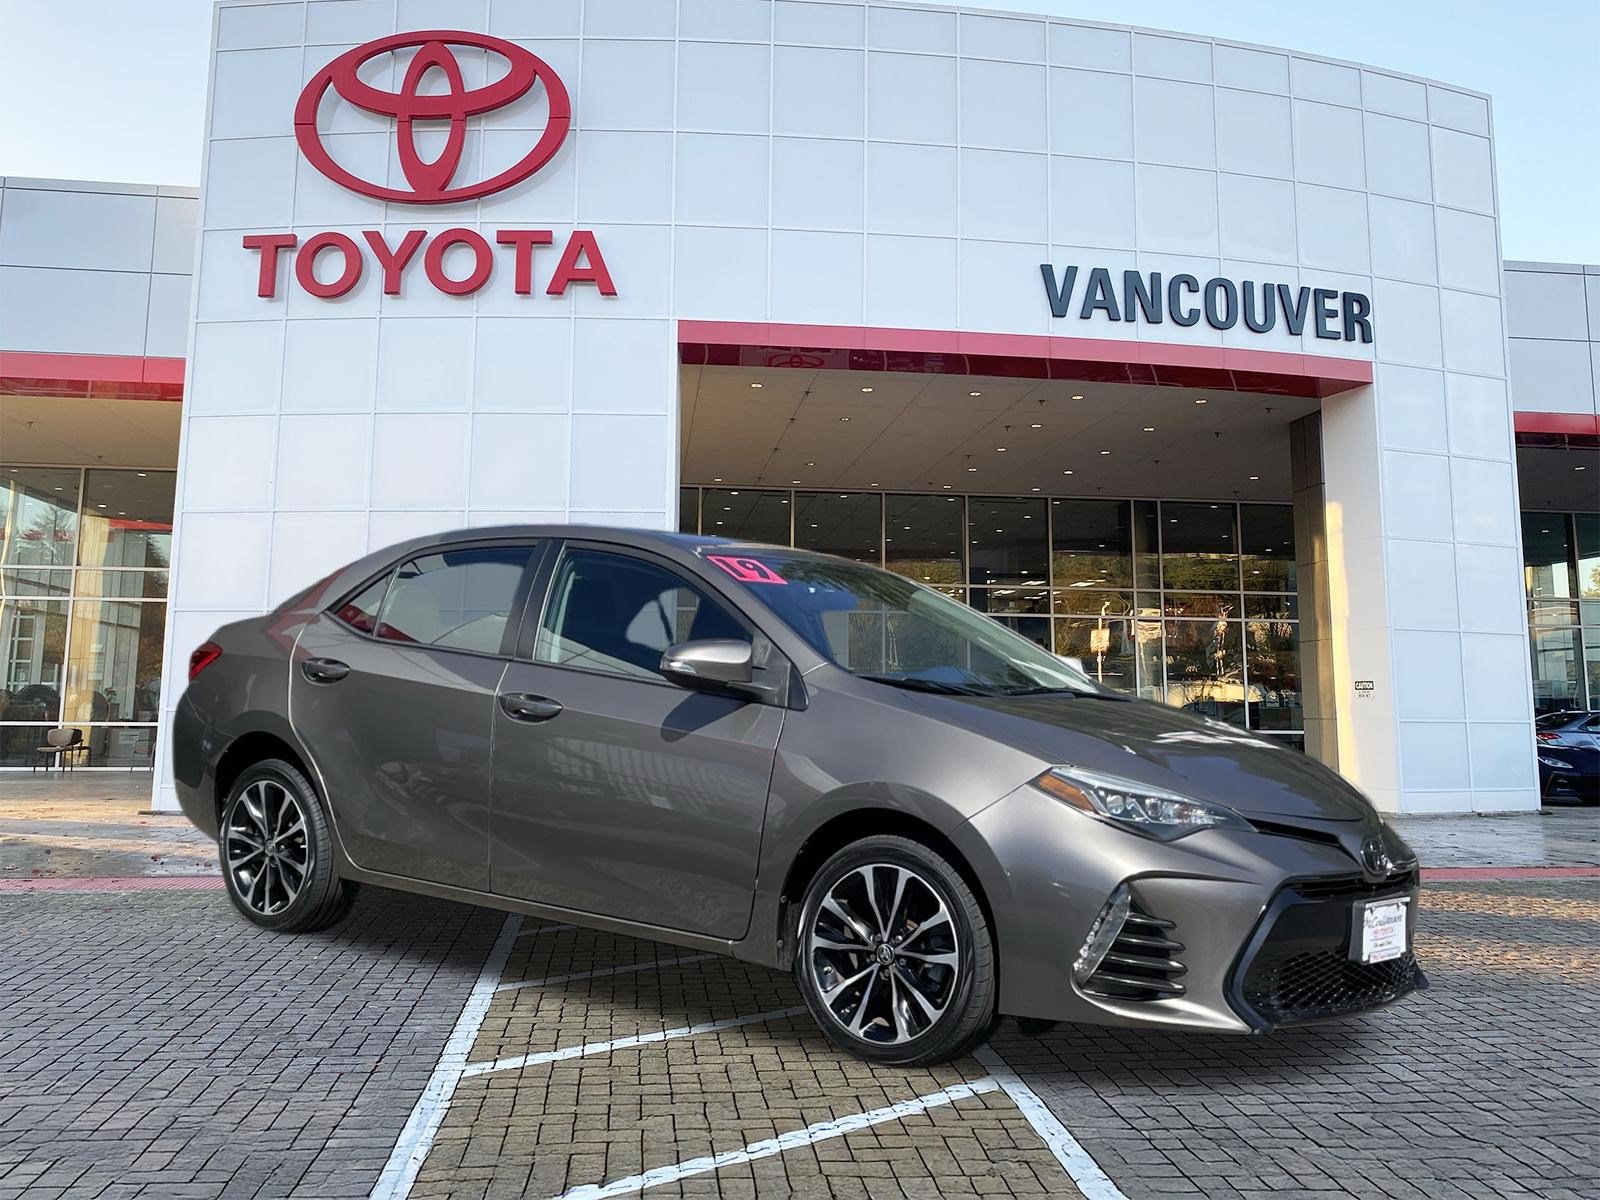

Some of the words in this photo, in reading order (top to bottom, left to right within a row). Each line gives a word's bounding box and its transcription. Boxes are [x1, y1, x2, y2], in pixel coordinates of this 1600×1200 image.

[242, 228, 618, 299] TOYOTA
[1040, 264, 1373, 344] VANCOUVER
[713, 557, 771, 580] 19
